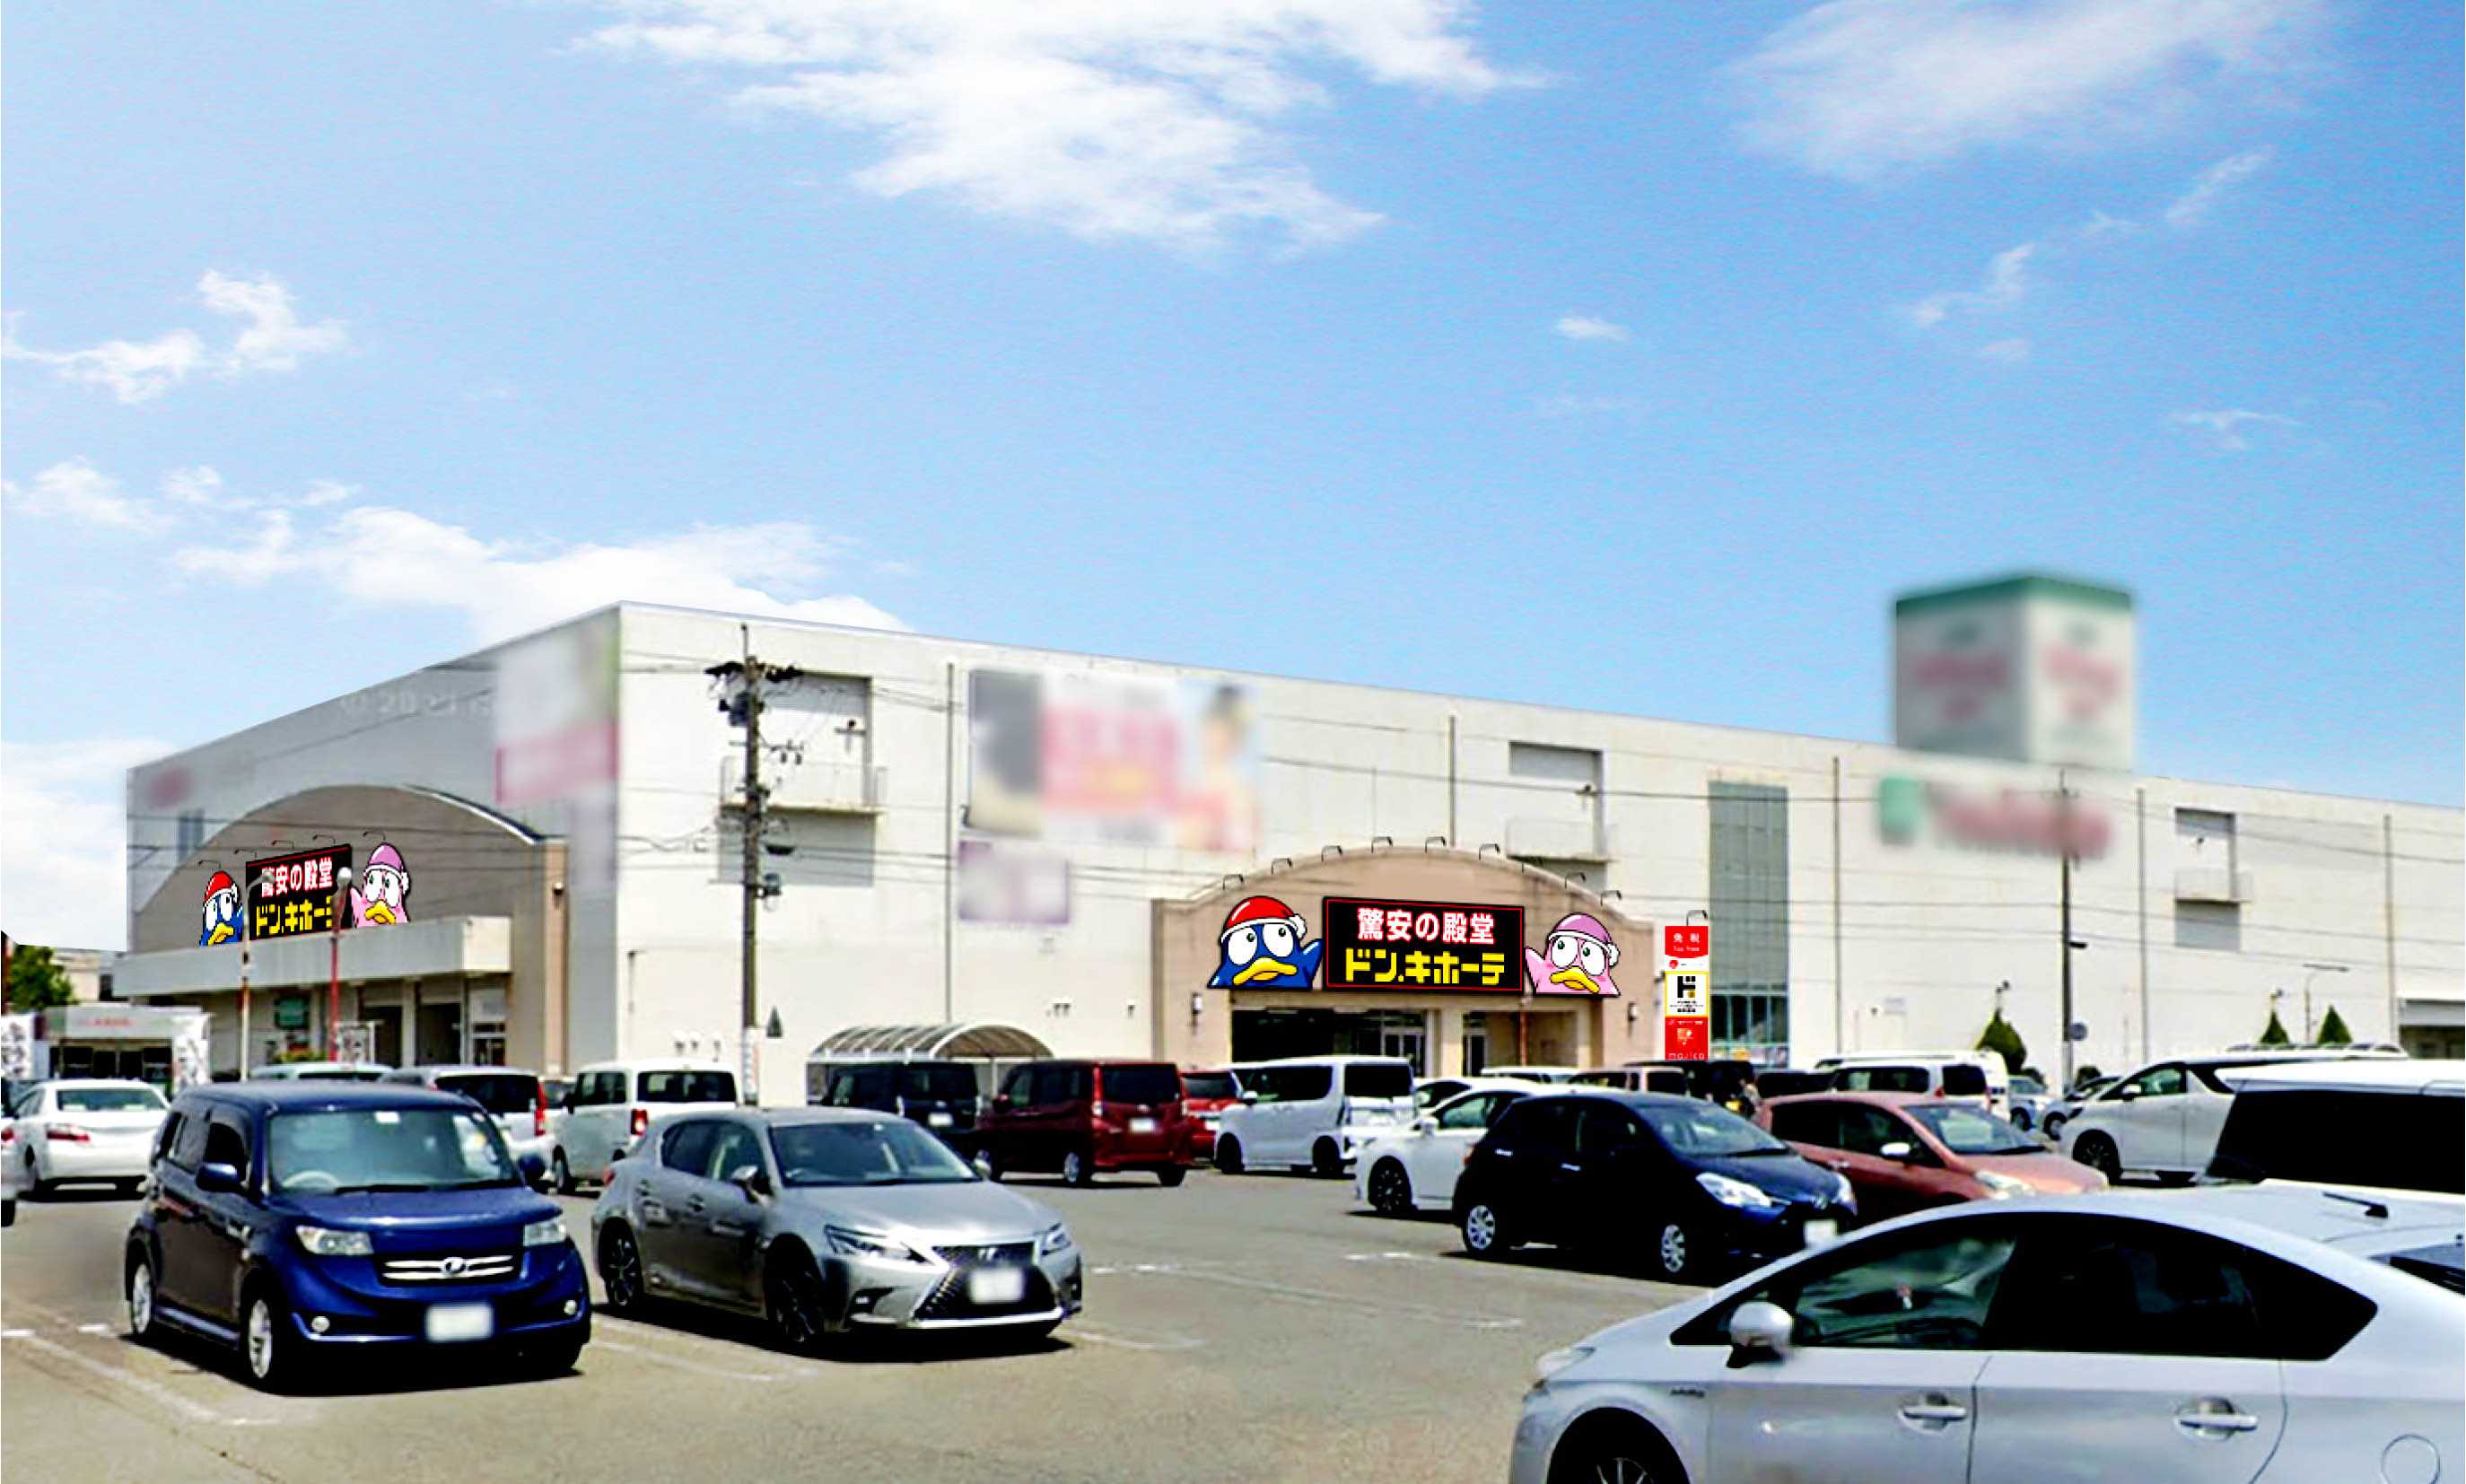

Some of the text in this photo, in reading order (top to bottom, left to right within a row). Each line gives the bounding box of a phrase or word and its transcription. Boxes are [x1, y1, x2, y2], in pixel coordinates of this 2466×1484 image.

[1357, 907, 1495, 945] 驚安の殿堂
